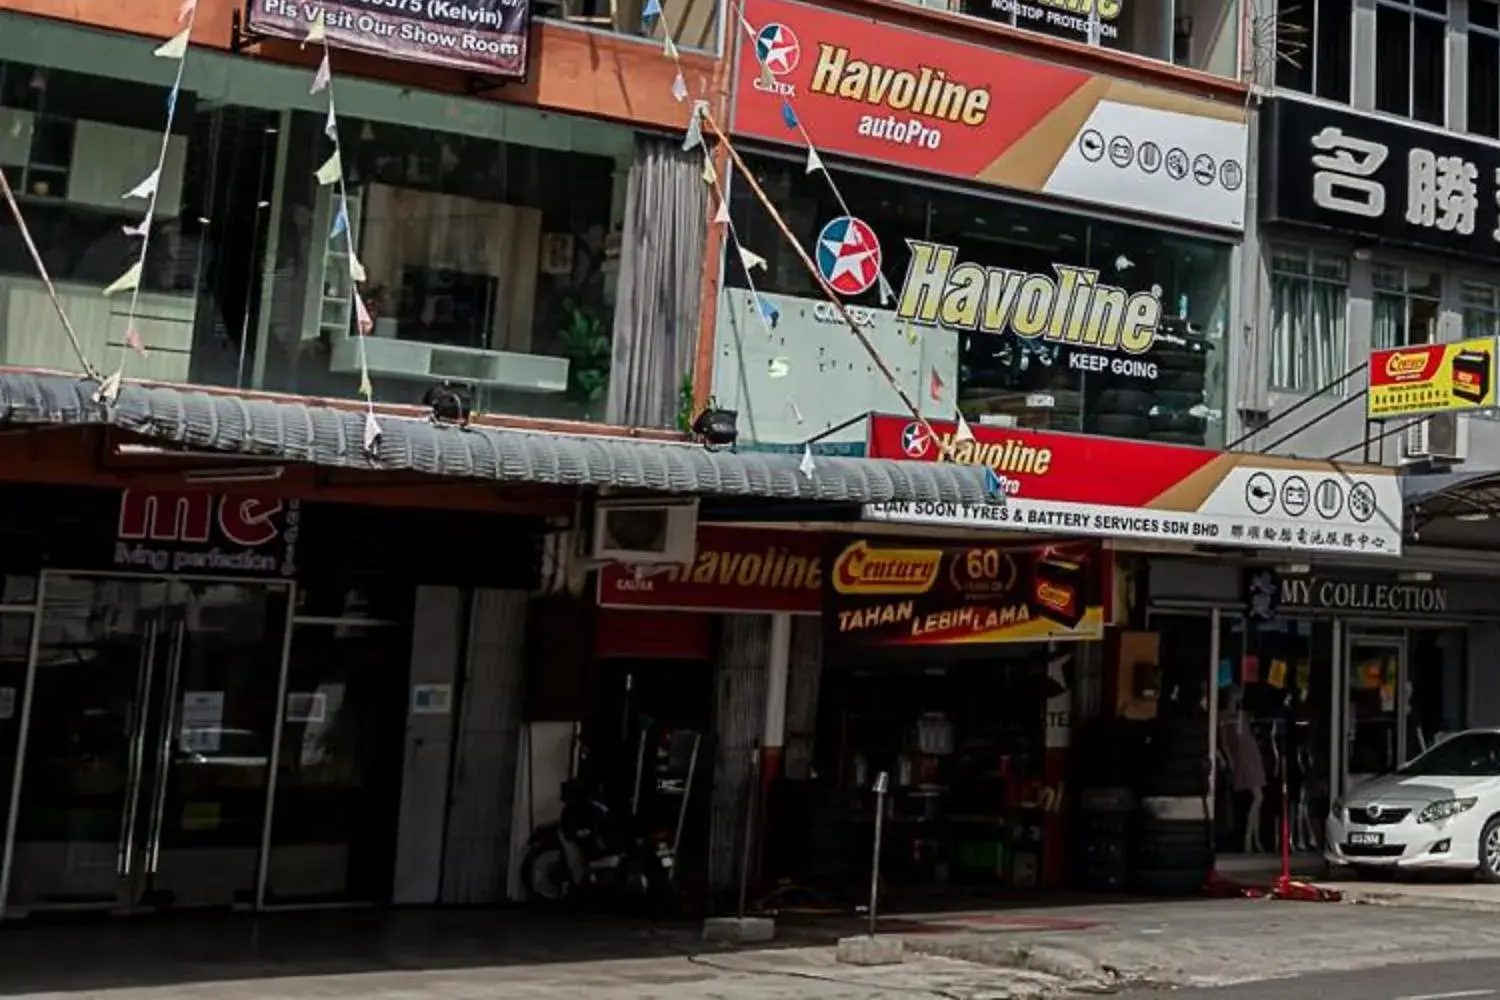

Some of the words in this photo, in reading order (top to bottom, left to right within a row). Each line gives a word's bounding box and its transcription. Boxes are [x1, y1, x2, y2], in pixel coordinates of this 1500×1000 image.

[303, 3, 354, 29] Vsit
[357, 14, 397, 37] Our
[400, 22, 457, 49] Show
[461, 32, 519, 56] Room
[753, 77, 796, 97] CLTEX
[809, 41, 991, 127] Havoline
[857, 113, 941, 150] autoPro
[897, 238, 1160, 355] Havoline
[1069, 351, 1109, 373] KEEP
[1111, 358, 1159, 380] GOING
[937, 432, 1052, 475] Havoline
[117, 488, 284, 547] me
[914, 500, 956, 517] SOON
[962, 502, 1009, 522] TYRES
[1012, 508, 1024, 523] &
[1028, 509, 1091, 529] BATTERY
[1094, 514, 1159, 533] SERVICES
[1162, 519, 1189, 535] SDN
[1192, 521, 1219, 537] BHD
[114, 541, 169, 571] living
[172, 545, 276, 571] perfection
[839, 547, 932, 588] Century
[966, 549, 1000, 579] 60
[1281, 577, 1316, 604] MY
[1320, 581, 1447, 612] COLLECTION
[837, 600, 915, 633] TAHAN
[911, 606, 974, 637] LEBIH
[972, 602, 1031, 632] LAMA
